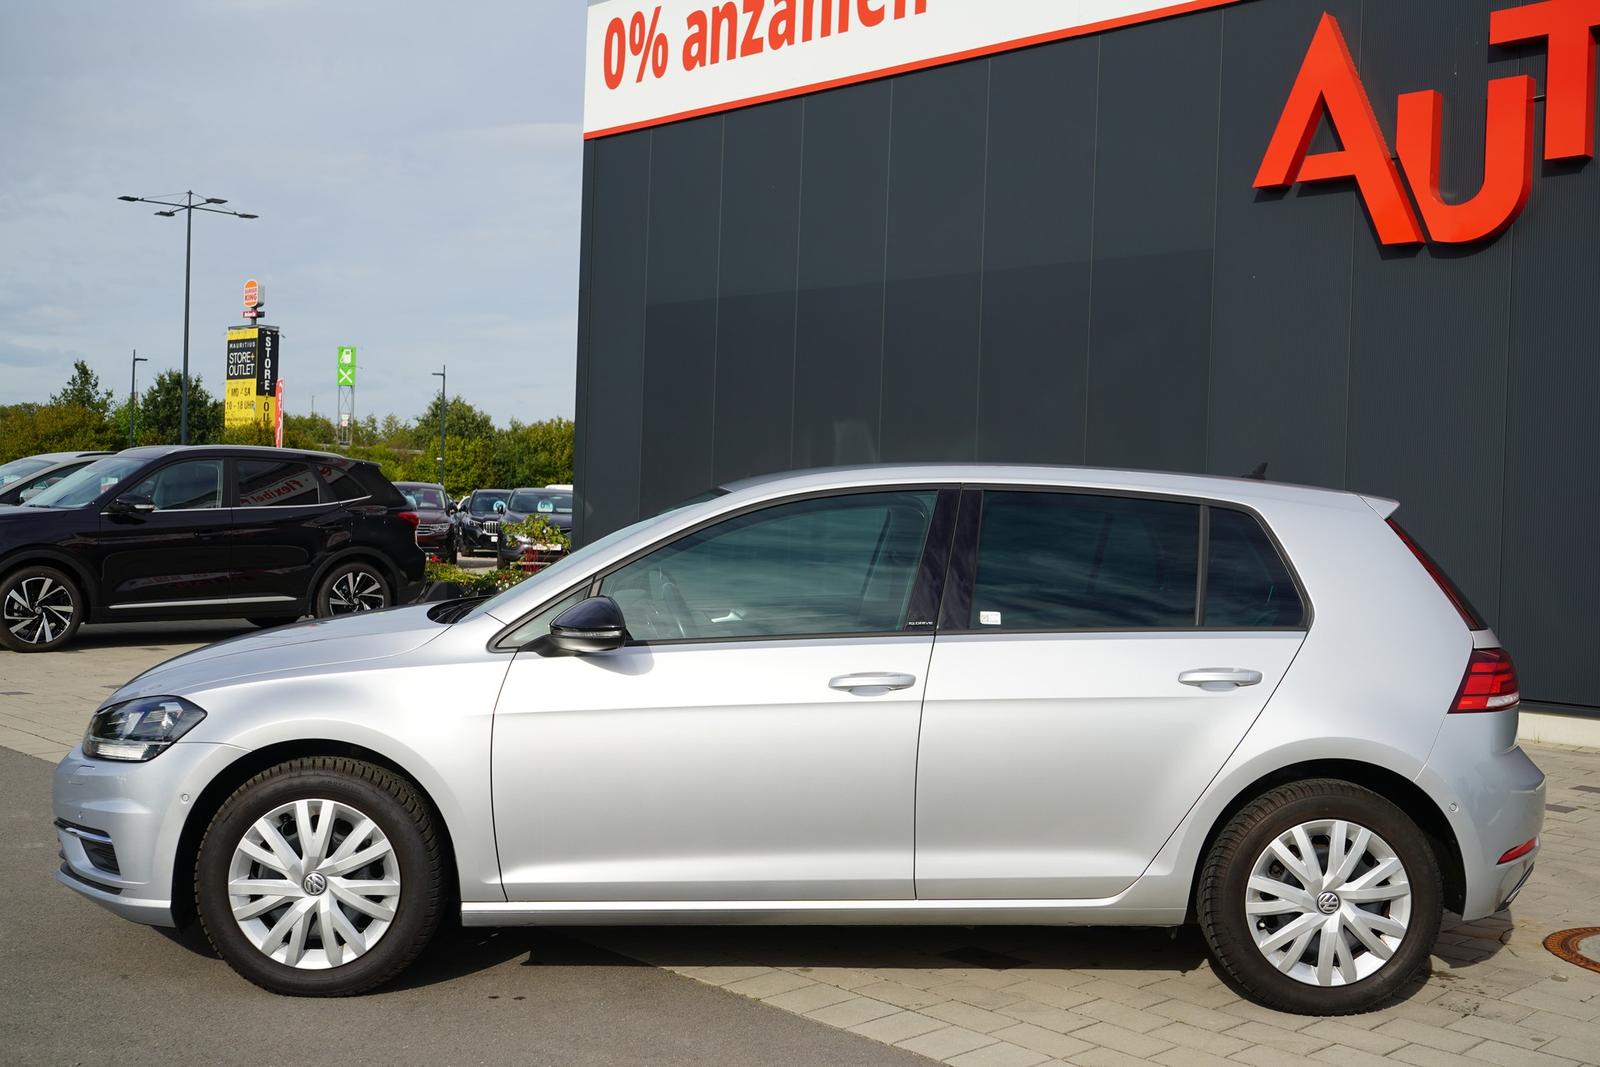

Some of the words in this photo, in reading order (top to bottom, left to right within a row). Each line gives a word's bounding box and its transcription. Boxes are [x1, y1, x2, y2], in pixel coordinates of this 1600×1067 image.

[604, 6, 669, 90] 0%
[682, 0, 927, 71] anza
[1252, 0, 1600, 245] AUT
[228, 363, 255, 376] OUTLET
[229, 341, 256, 349] MAURITIUS
